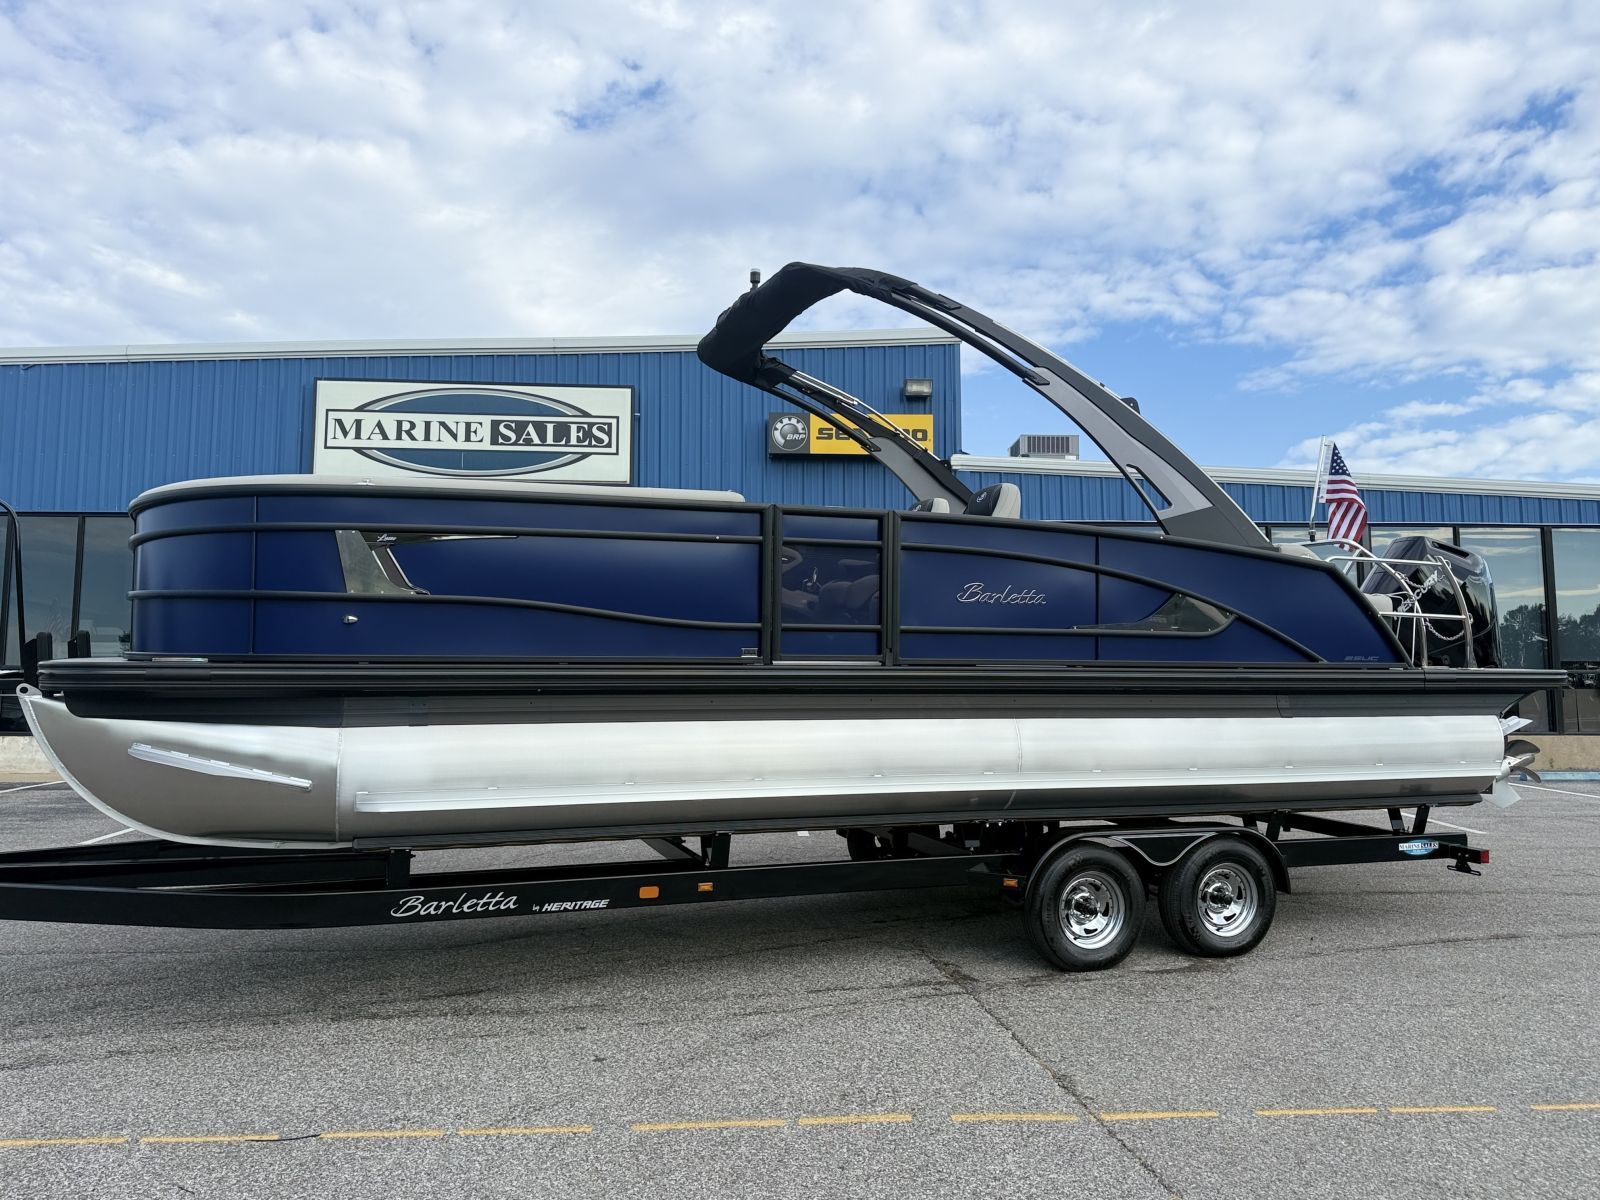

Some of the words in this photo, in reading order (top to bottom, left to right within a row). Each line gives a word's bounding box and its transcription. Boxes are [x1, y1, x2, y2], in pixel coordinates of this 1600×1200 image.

[330, 417, 484, 443] MARINE
[498, 421, 611, 446] SALES
[786, 433, 806, 441] BRP
[956, 582, 1047, 604] Barletta
[390, 892, 519, 917] Barletta
[542, 899, 610, 912] HERITAGE
